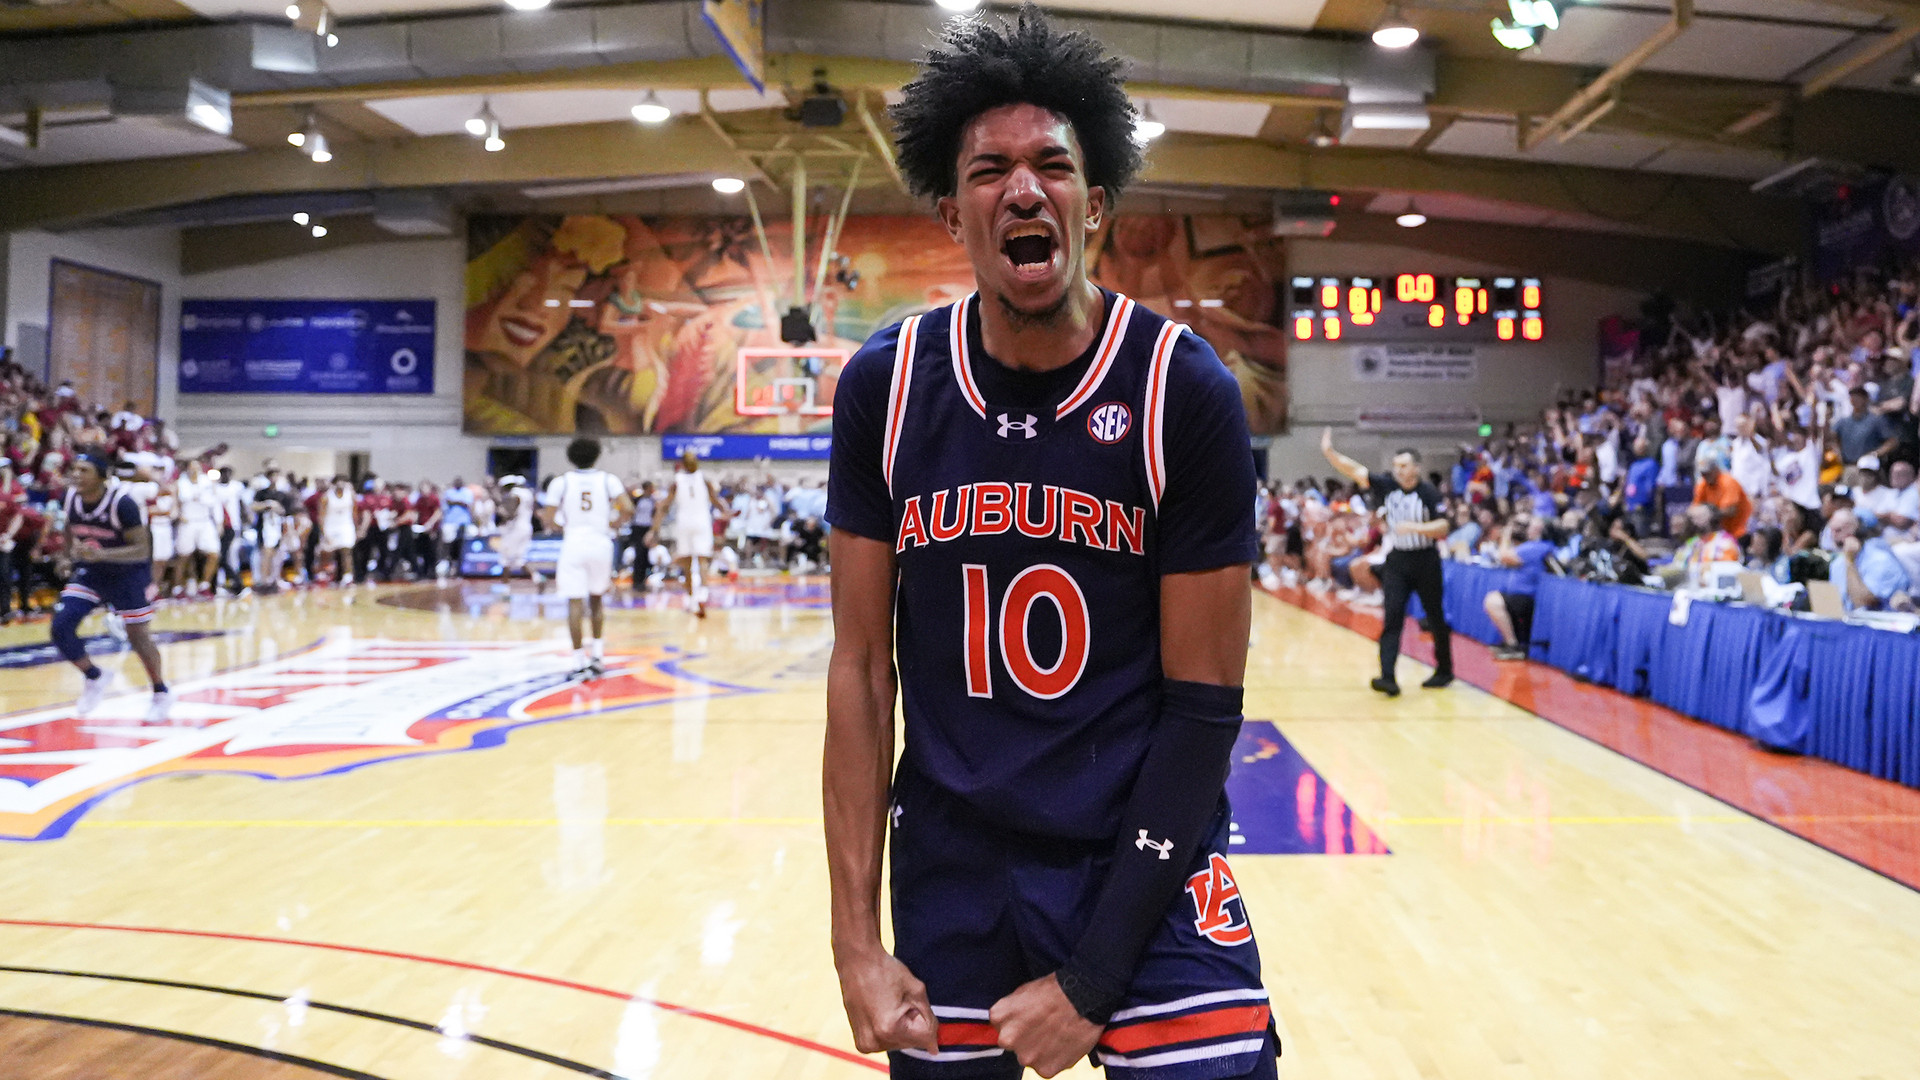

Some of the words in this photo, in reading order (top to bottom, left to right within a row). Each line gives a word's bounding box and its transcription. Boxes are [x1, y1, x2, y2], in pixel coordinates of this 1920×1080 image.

[1092, 404, 1128, 441] SEC
[581, 491, 593, 511] 5
[896, 482, 1146, 555] AUBURN
[962, 563, 1091, 700] 10
